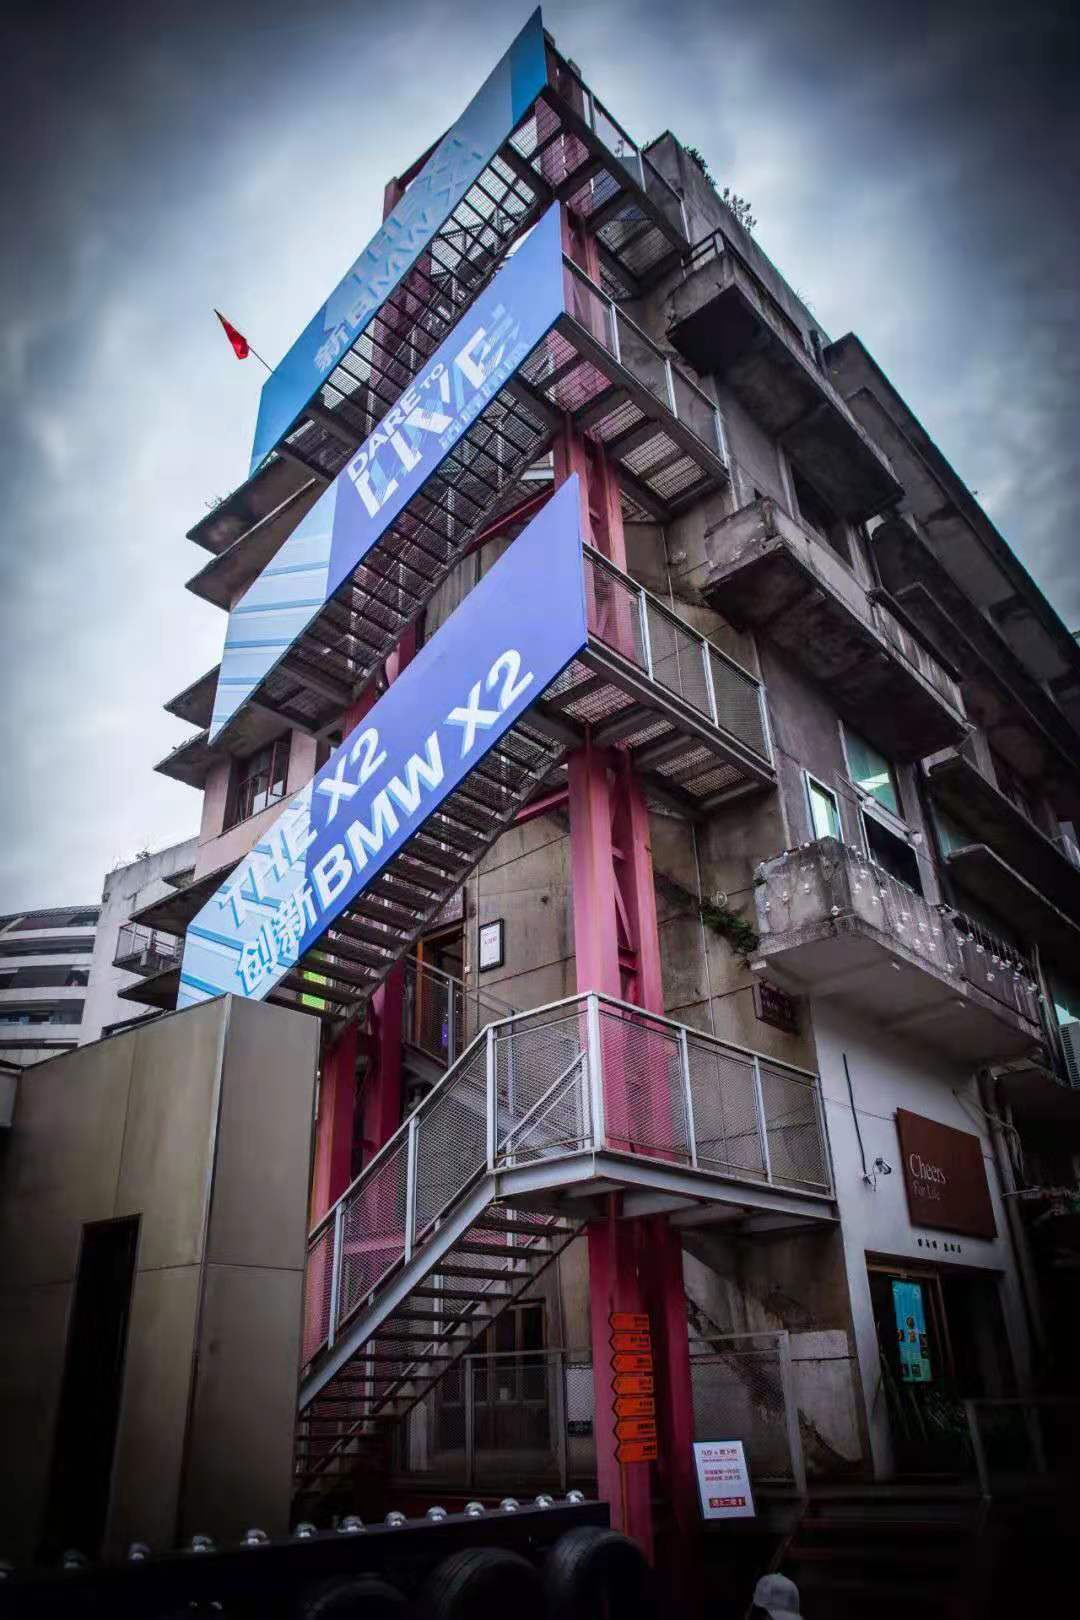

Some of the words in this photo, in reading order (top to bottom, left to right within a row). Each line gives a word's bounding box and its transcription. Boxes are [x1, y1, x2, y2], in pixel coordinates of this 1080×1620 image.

[346, 387, 422, 483] DARE
[419, 361, 446, 396] TO
[353, 318, 514, 520] LIVE
[443, 648, 535, 759] X2
[219, 805, 318, 927] THE
[315, 727, 388, 828] X2
[909, 1152, 946, 1184] Cheers
